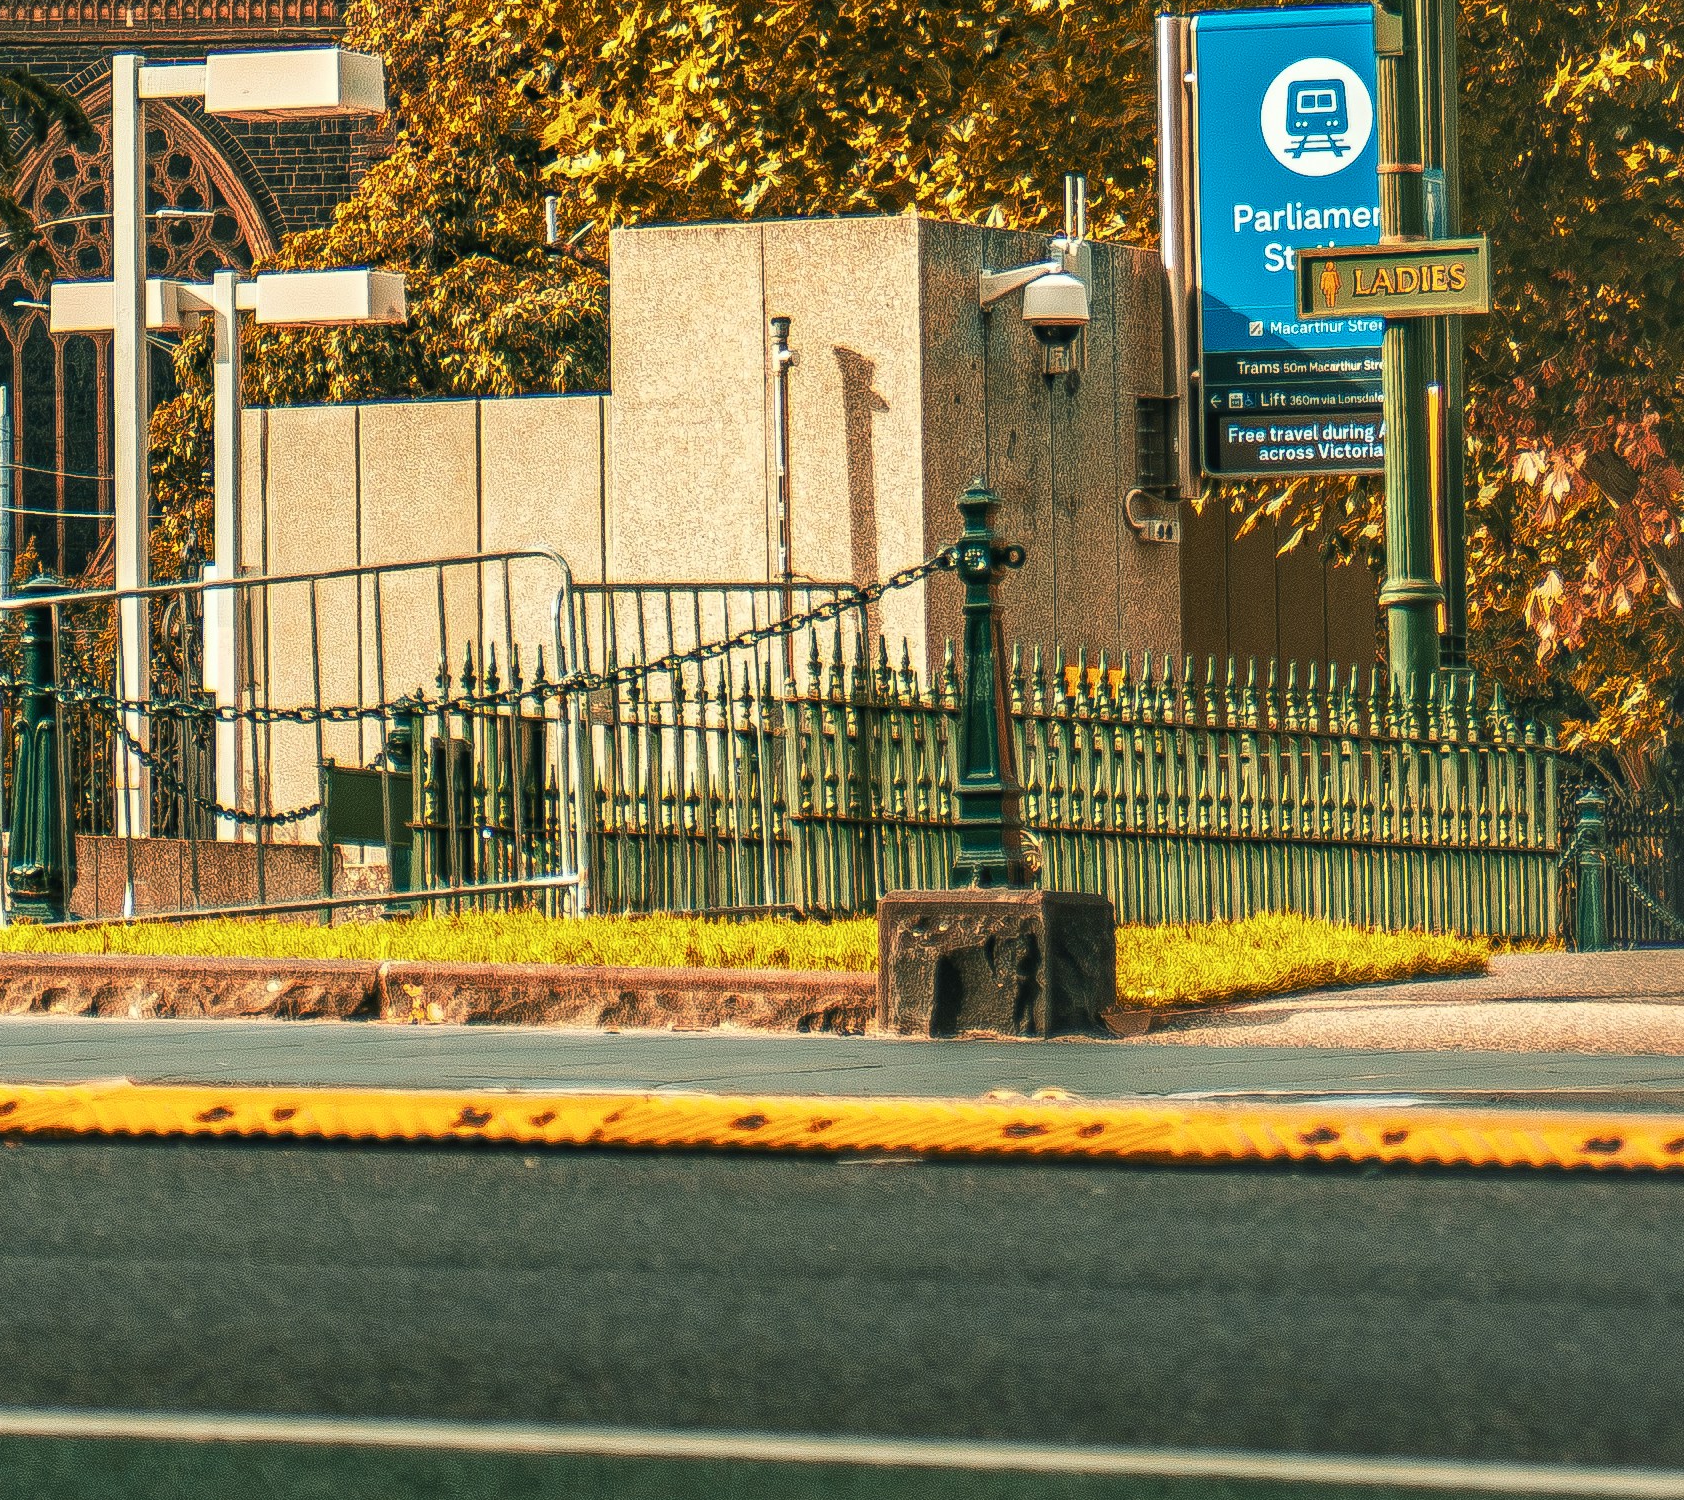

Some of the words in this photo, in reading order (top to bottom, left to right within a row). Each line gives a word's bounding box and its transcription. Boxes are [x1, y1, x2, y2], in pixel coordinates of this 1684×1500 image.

[1353, 263, 1467, 297] LADIES
[1270, 320, 1344, 335] Macarthur
[1237, 360, 1280, 375] Trams
[1283, 362, 1307, 373] 50m
[1309, 361, 1362, 373] Macarthur
[1261, 391, 1286, 407] Lift
[1290, 394, 1319, 406] 360m
[1228, 427, 1266, 443] Free
[1270, 424, 1318, 442] travel
[1322, 422, 1375, 442] during
[1259, 448, 1314, 461] across
[1319, 443, 1384, 459] Victoria
